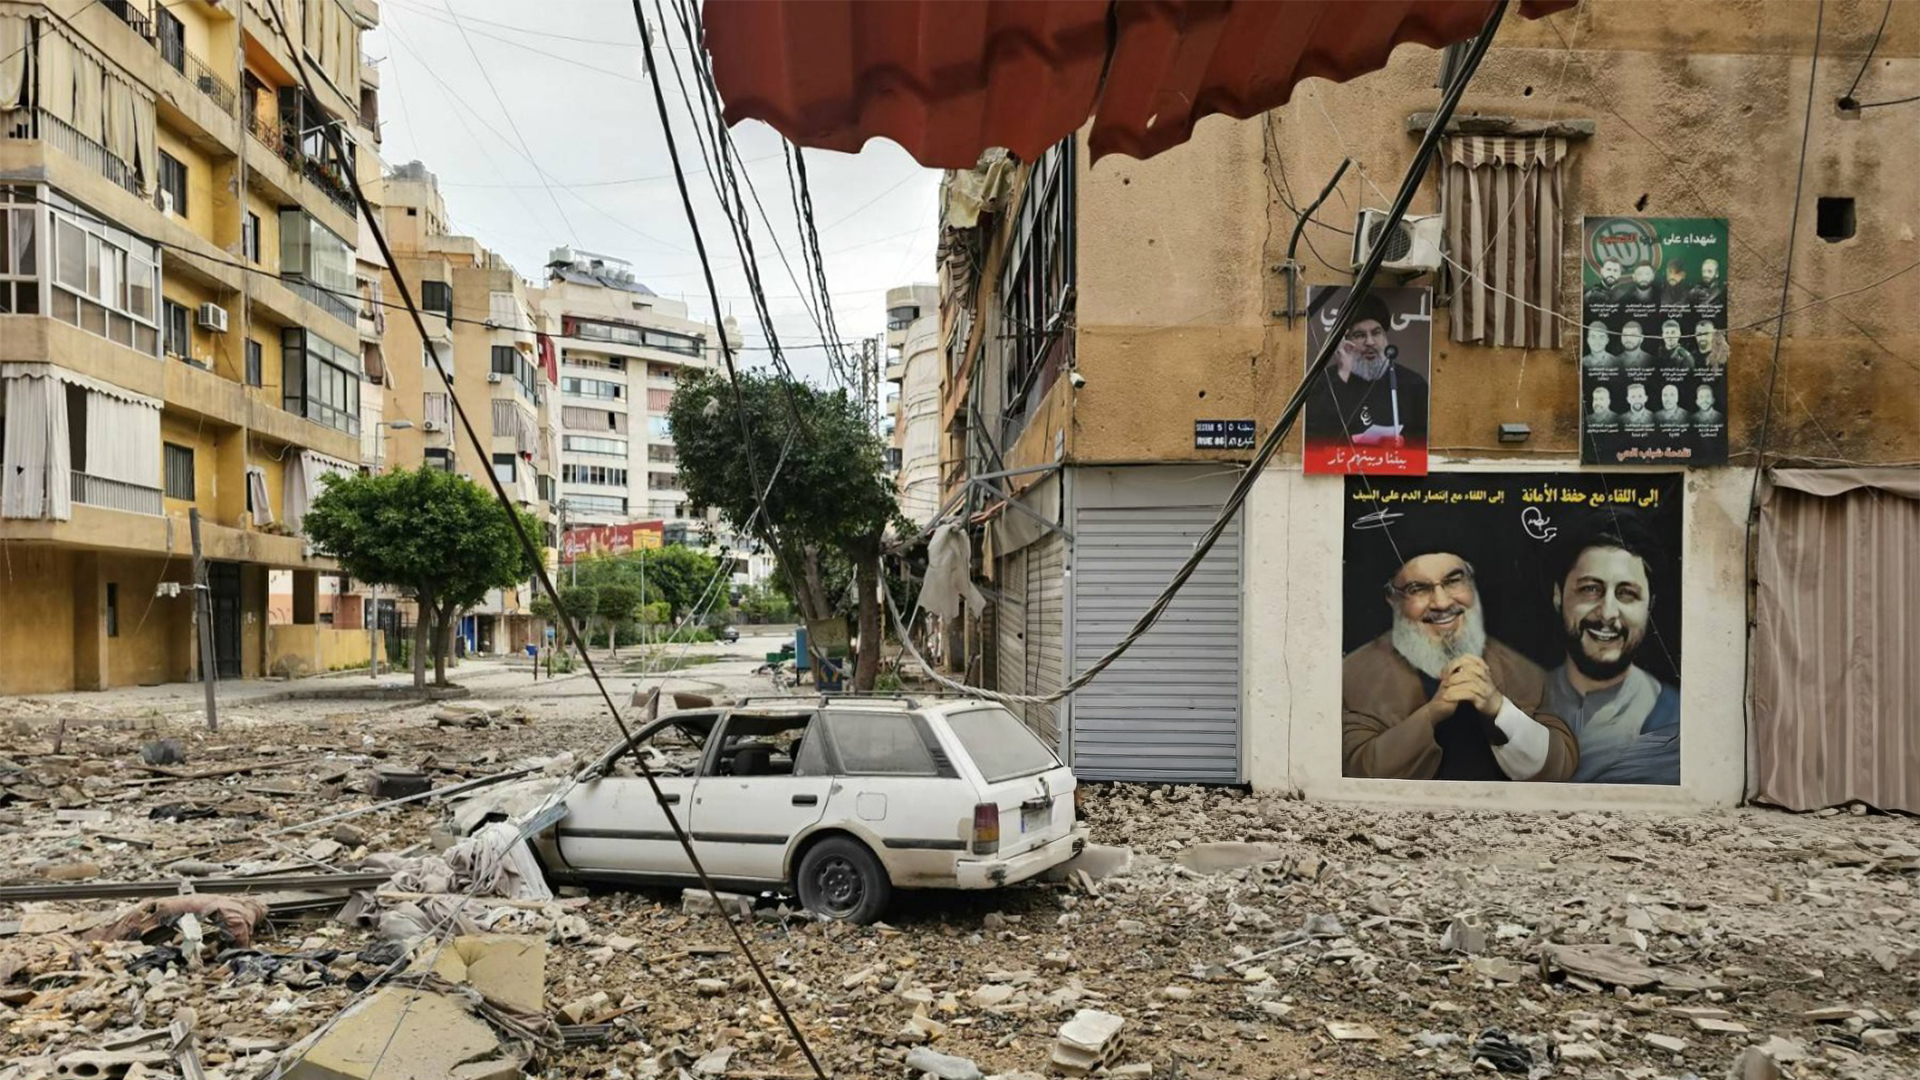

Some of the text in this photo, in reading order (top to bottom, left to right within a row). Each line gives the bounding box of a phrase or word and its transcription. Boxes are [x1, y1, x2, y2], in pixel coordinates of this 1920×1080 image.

[1663, 233, 1682, 246] على
[1683, 233, 1717, 247] شهداء
[1217, 423, 1223, 431] 5
[1197, 437, 1213, 445] RUE
[1616, 447, 1639, 461] الحي
[1352, 489, 1505, 504] إلى اللقاء مع إنتصار الدم على السيف
[1521, 483, 1659, 507] إلى اللقاء مع حفظ الأمانة
